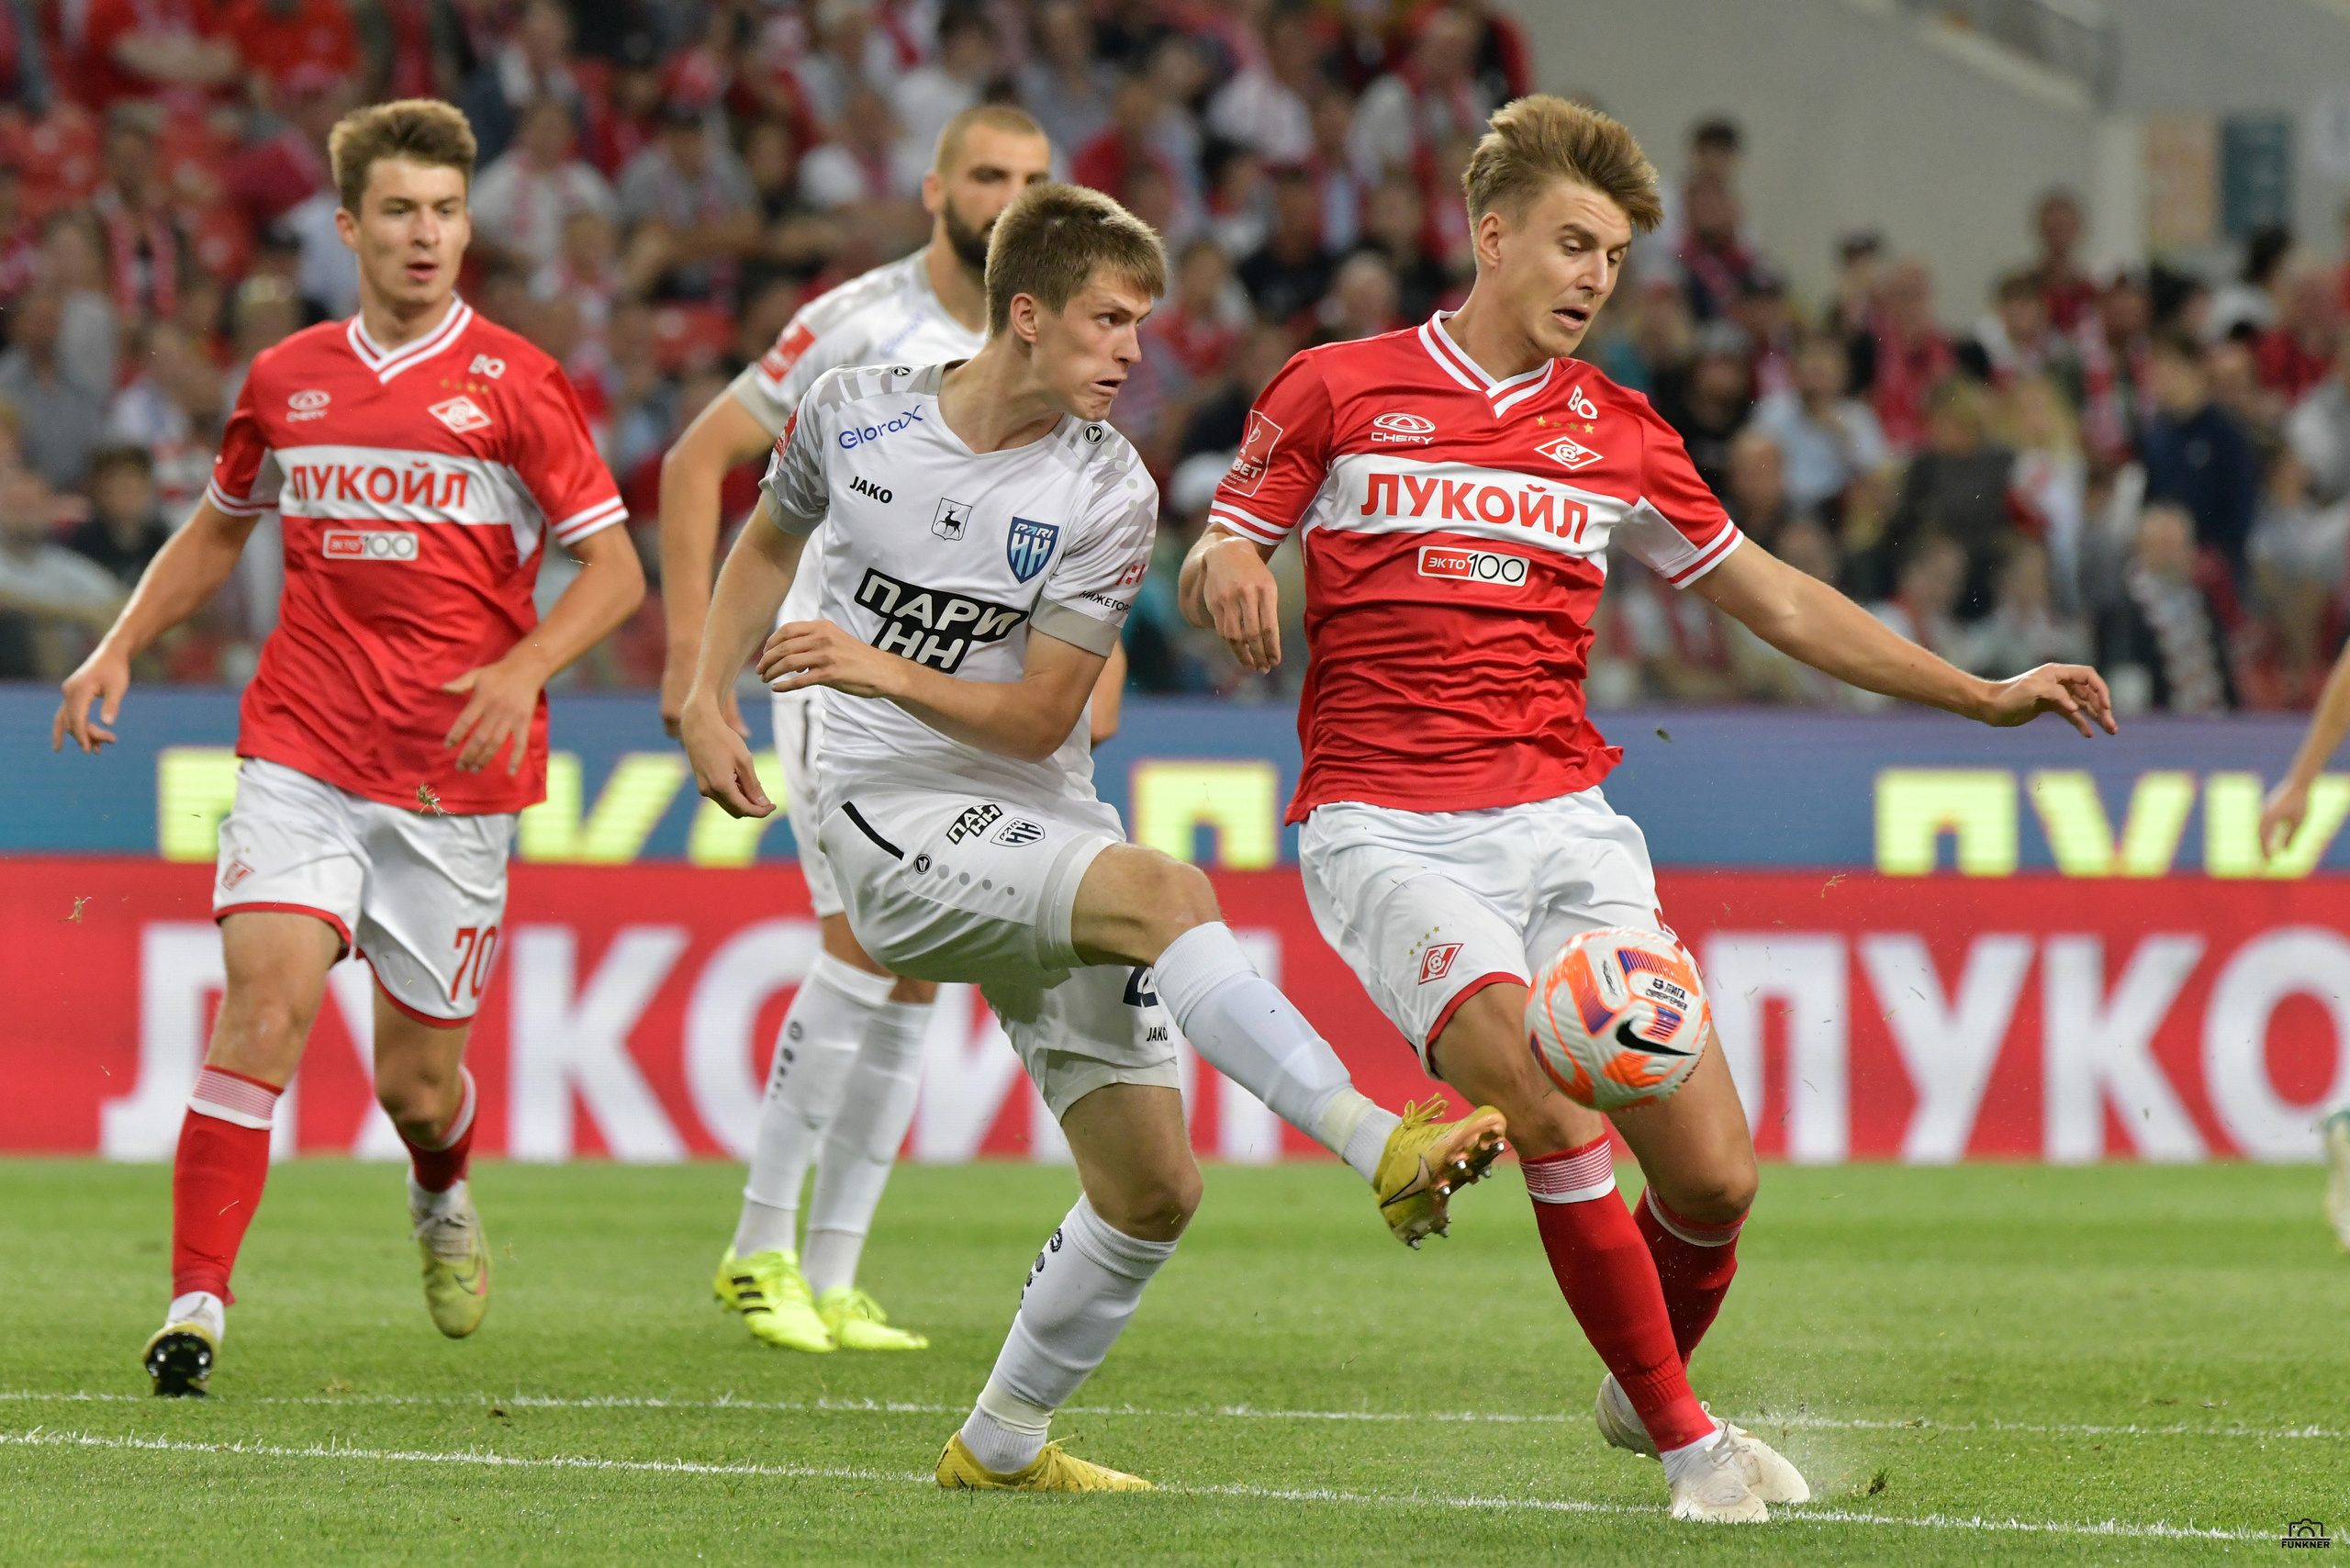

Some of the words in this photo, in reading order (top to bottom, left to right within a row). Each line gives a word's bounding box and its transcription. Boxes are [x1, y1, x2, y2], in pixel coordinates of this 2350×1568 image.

[838, 404, 923, 449] GloraX
[1371, 431, 1435, 445] CHERY
[291, 461, 469, 508] ЛУКОЙЛ
[849, 476, 893, 504] JAKO
[1360, 473, 1589, 544] ЛУКОЙЛ
[1427, 556, 1466, 570] ЭКТО
[1468, 553, 1525, 583] 100
[860, 574, 1022, 636] ПАРИ
[878, 621, 965, 669] НН
[450, 924, 498, 1002] 70
[1146, 1025, 1169, 1042] JAKO
